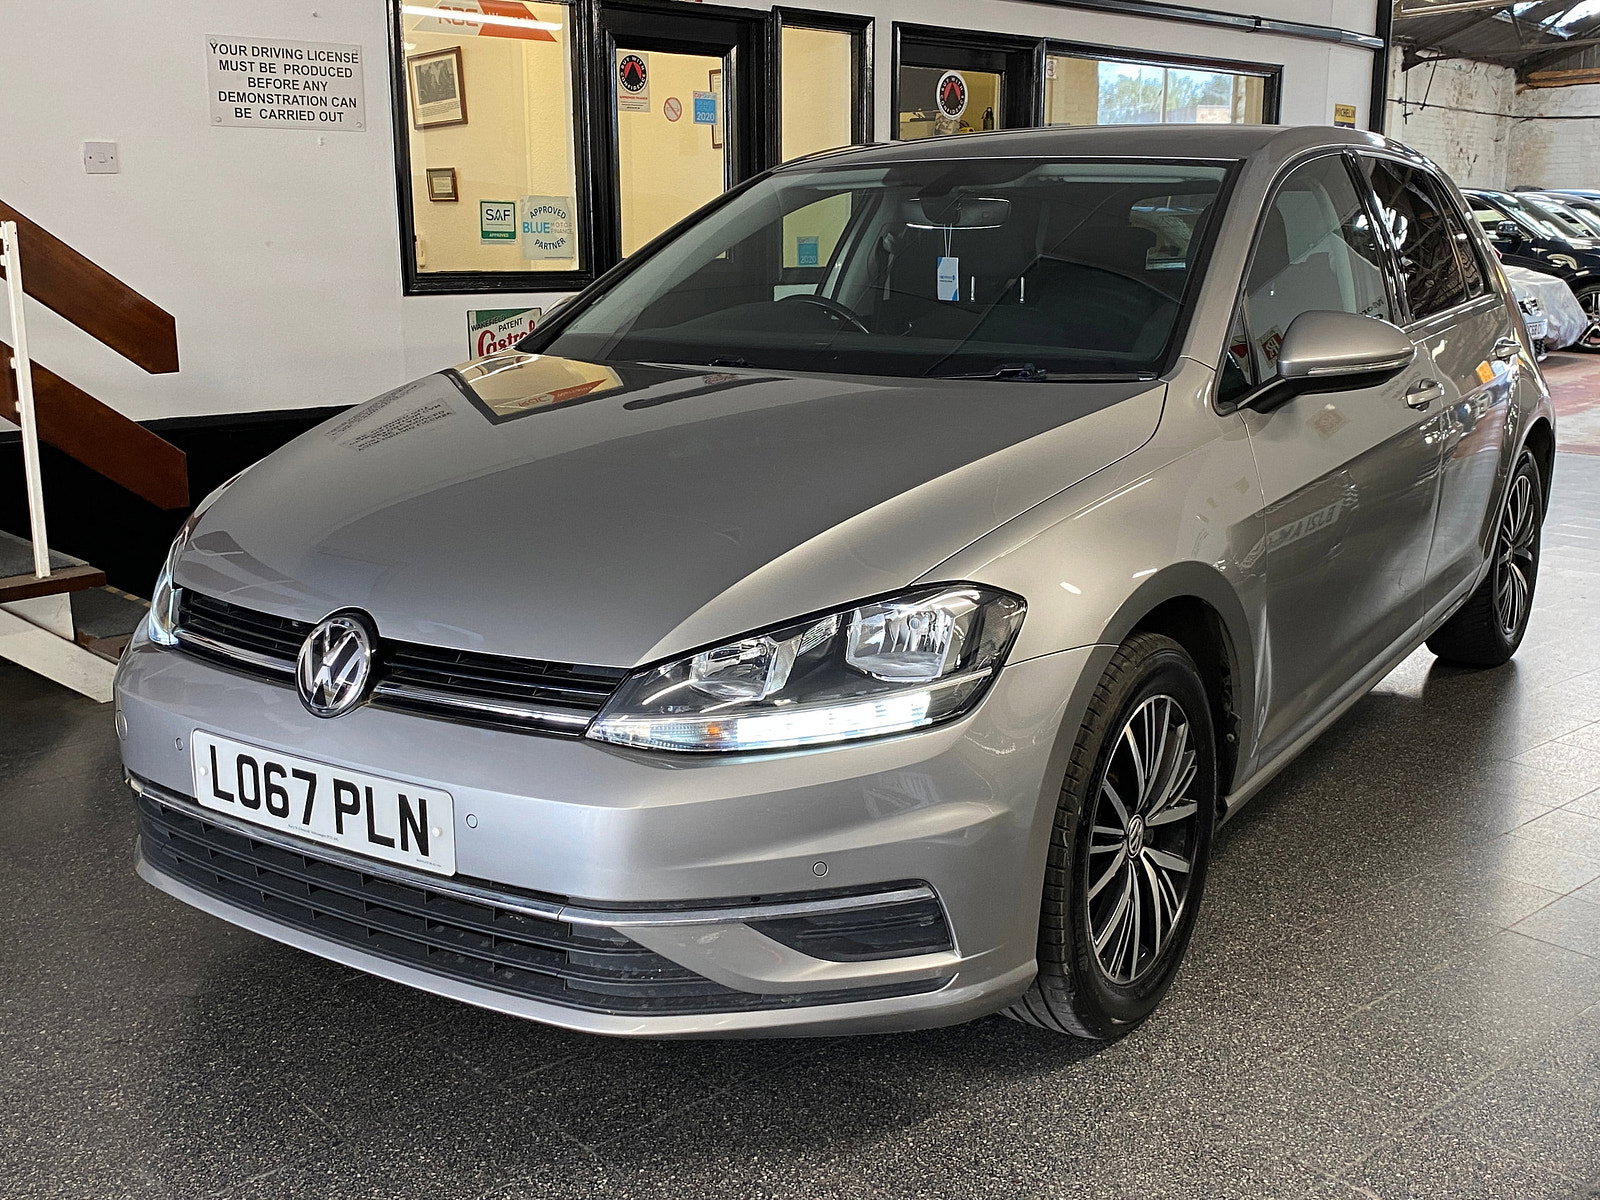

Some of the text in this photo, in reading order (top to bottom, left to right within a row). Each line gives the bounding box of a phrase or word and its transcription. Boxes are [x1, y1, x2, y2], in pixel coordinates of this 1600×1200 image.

[210, 43, 359, 64] YOUR DRIVING LICENSE
[219, 59, 353, 78] MUST BE PRODUCED
[247, 76, 328, 92] BEFORE ANY
[218, 90, 357, 108] DEMONSTRATION CAN
[234, 107, 344, 123] BE CARRIED OUT
[696, 111, 715, 122] 2020
[485, 208, 511, 221] SAF
[529, 205, 566, 219] APPROVED
[522, 221, 550, 234] BLUE
[534, 237, 566, 250] PARTNER
[498, 317, 523, 333] PATENT
[209, 744, 430, 857] LO67 PLN
